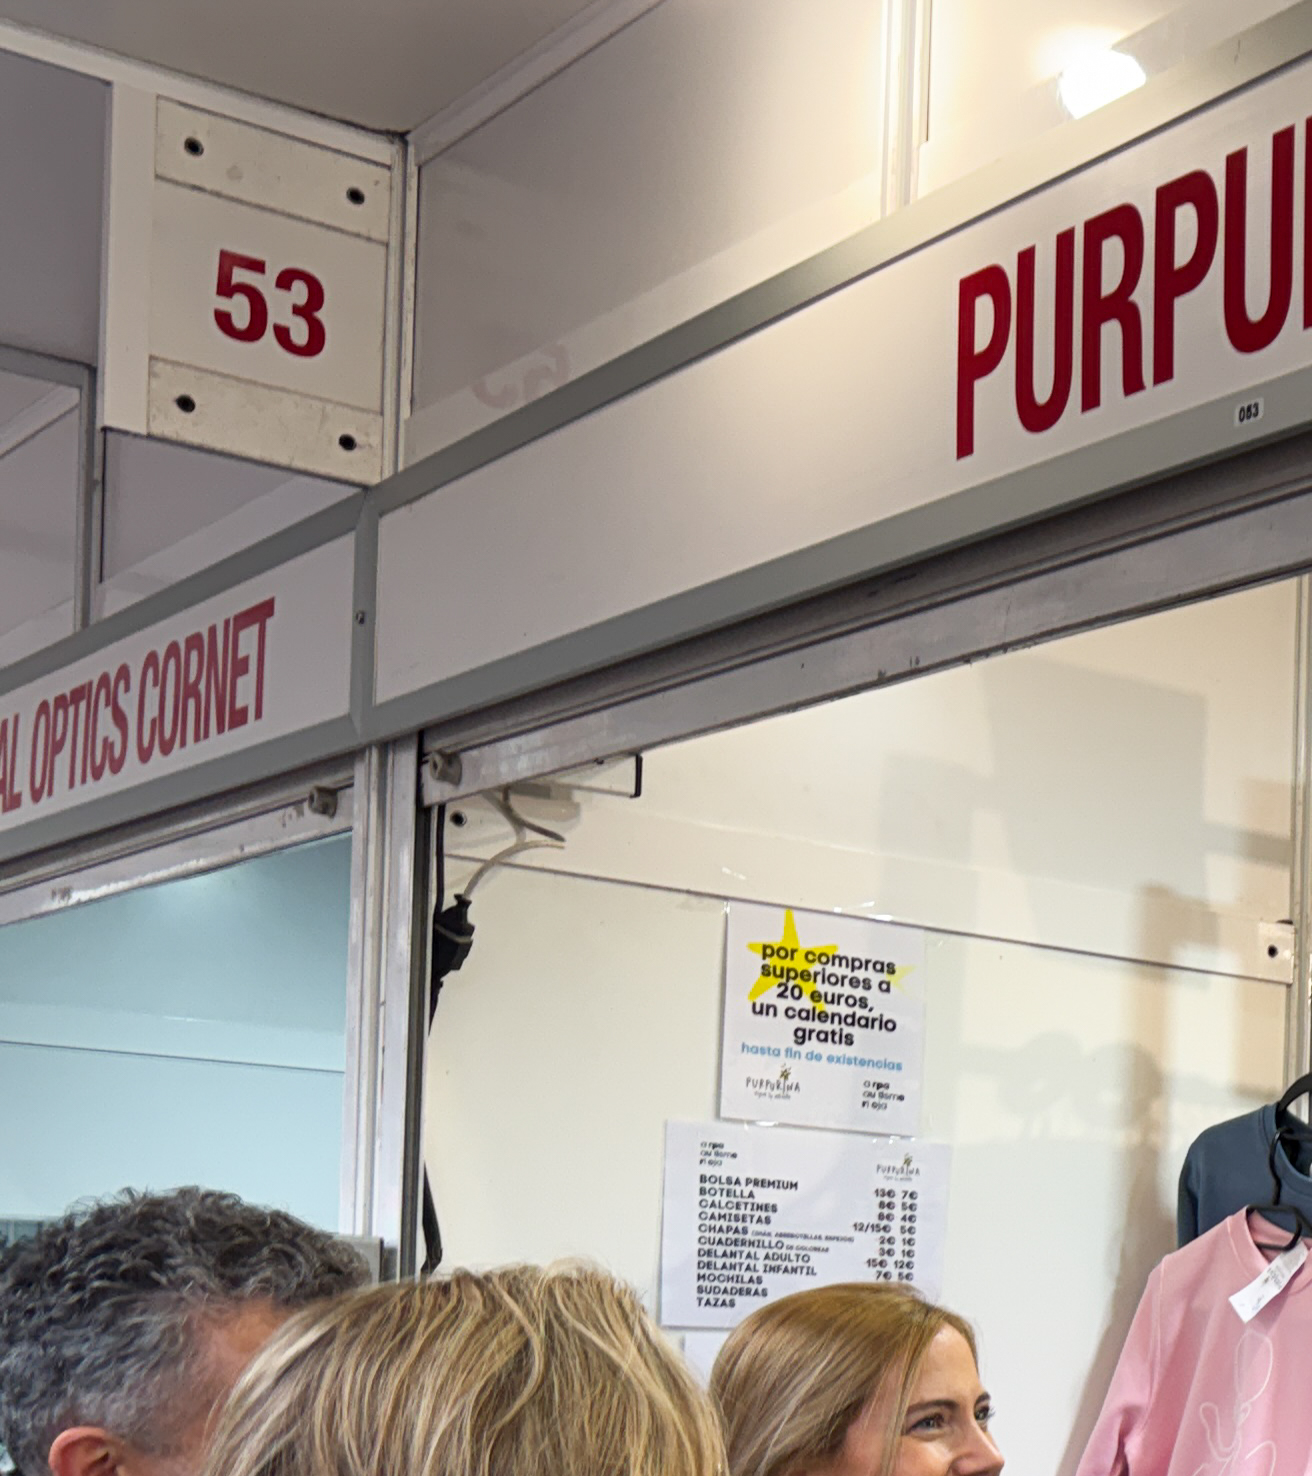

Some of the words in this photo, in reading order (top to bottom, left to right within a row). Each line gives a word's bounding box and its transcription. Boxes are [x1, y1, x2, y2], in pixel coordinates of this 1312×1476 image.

[213, 248, 327, 358] 53
[29, 662, 131, 804] OPTICS
[136, 595, 275, 765] CORNET
[762, 944, 798, 961] por
[804, 951, 896, 975] compras
[761, 963, 872, 991] superiores
[878, 980, 891, 993] a
[776, 982, 803, 1000] 20
[810, 989, 874, 1012] euros,
[752, 1002, 777, 1017] un
[784, 1006, 897, 1032] calendario
[793, 1027, 854, 1046] gratis
[741, 1042, 781, 1058] hasta
[784, 1047, 802, 1060] fin
[805, 1050, 822, 1062] de
[826, 1053, 902, 1071] existencias
[700, 1174, 741, 1186] BOLSA
[745, 1177, 798, 1190] PREMIUM
[699, 1186, 755, 1199] BOTELLA
[699, 1199, 778, 1213] CALCETINES
[699, 1211, 771, 1225] CAMISETAS
[698, 1224, 748, 1236] CHAPAS
[698, 1236, 784, 1249] CUADERNILLO
[698, 1248, 760, 1261] DELANTAL
[763, 1252, 810, 1263] ADULTO
[697, 1260, 759, 1272] DELANTAL
[763, 1264, 817, 1276] INFANTIL
[697, 1273, 763, 1285] MOCHILAS
[697, 1285, 768, 1297] SUDADERAS
[697, 1297, 735, 1308] TAZAS
